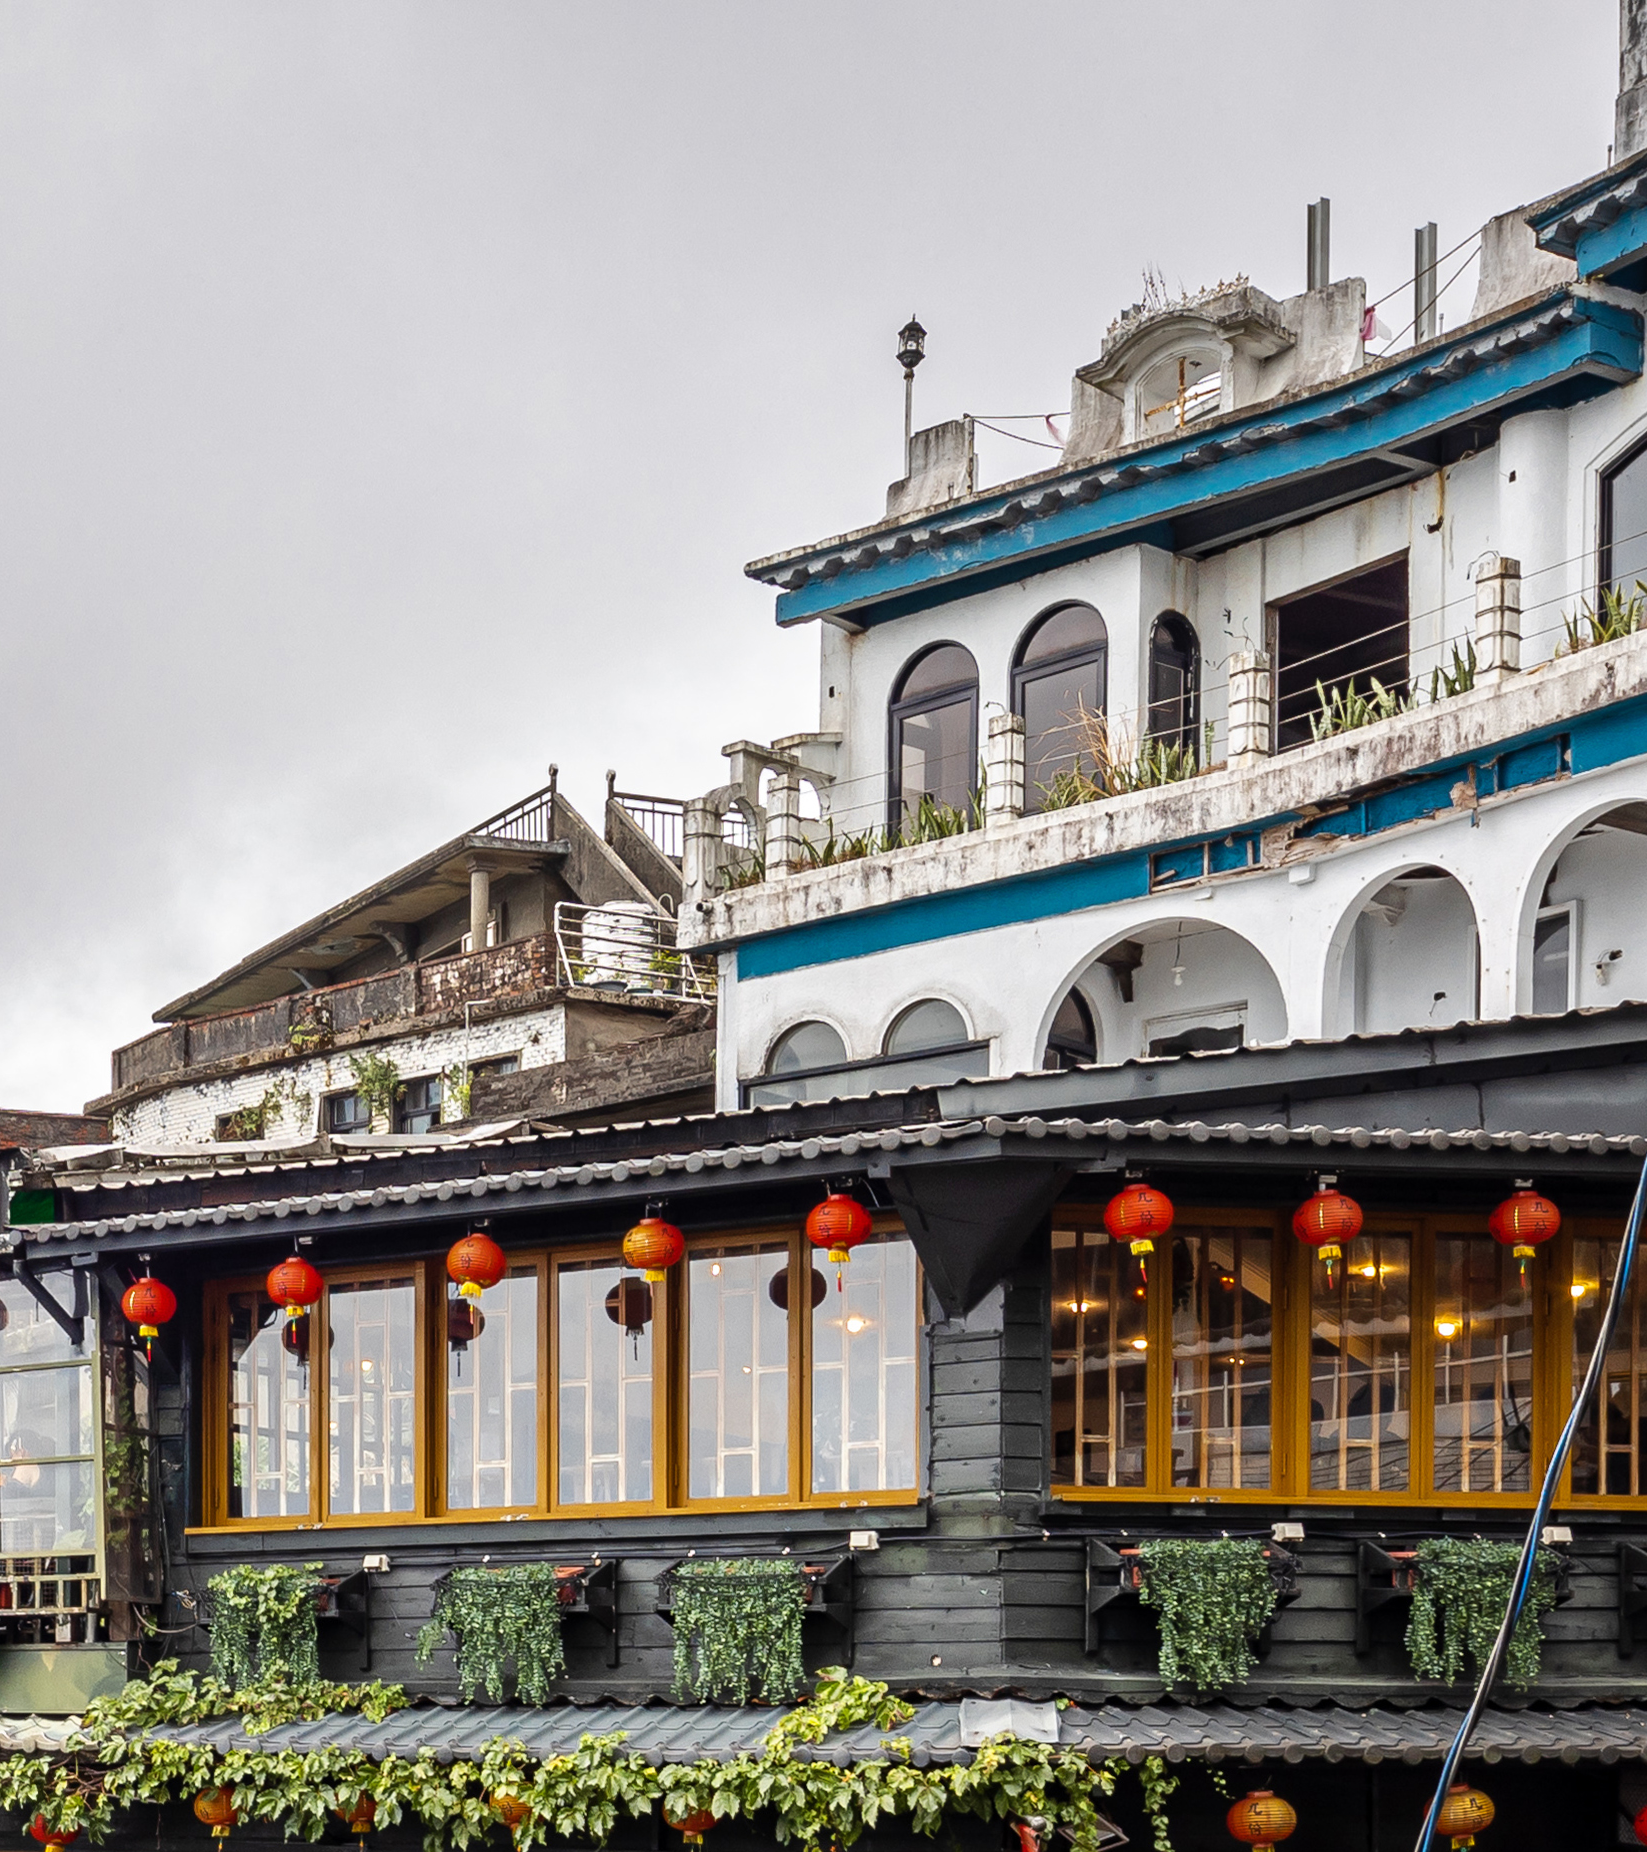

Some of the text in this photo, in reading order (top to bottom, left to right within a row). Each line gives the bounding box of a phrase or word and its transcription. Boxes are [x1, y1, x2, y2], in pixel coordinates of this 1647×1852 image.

[1137, 1191, 1154, 1228] 九份
[1533, 1201, 1549, 1234] 九份
[1248, 1802, 1263, 1838] 九份
